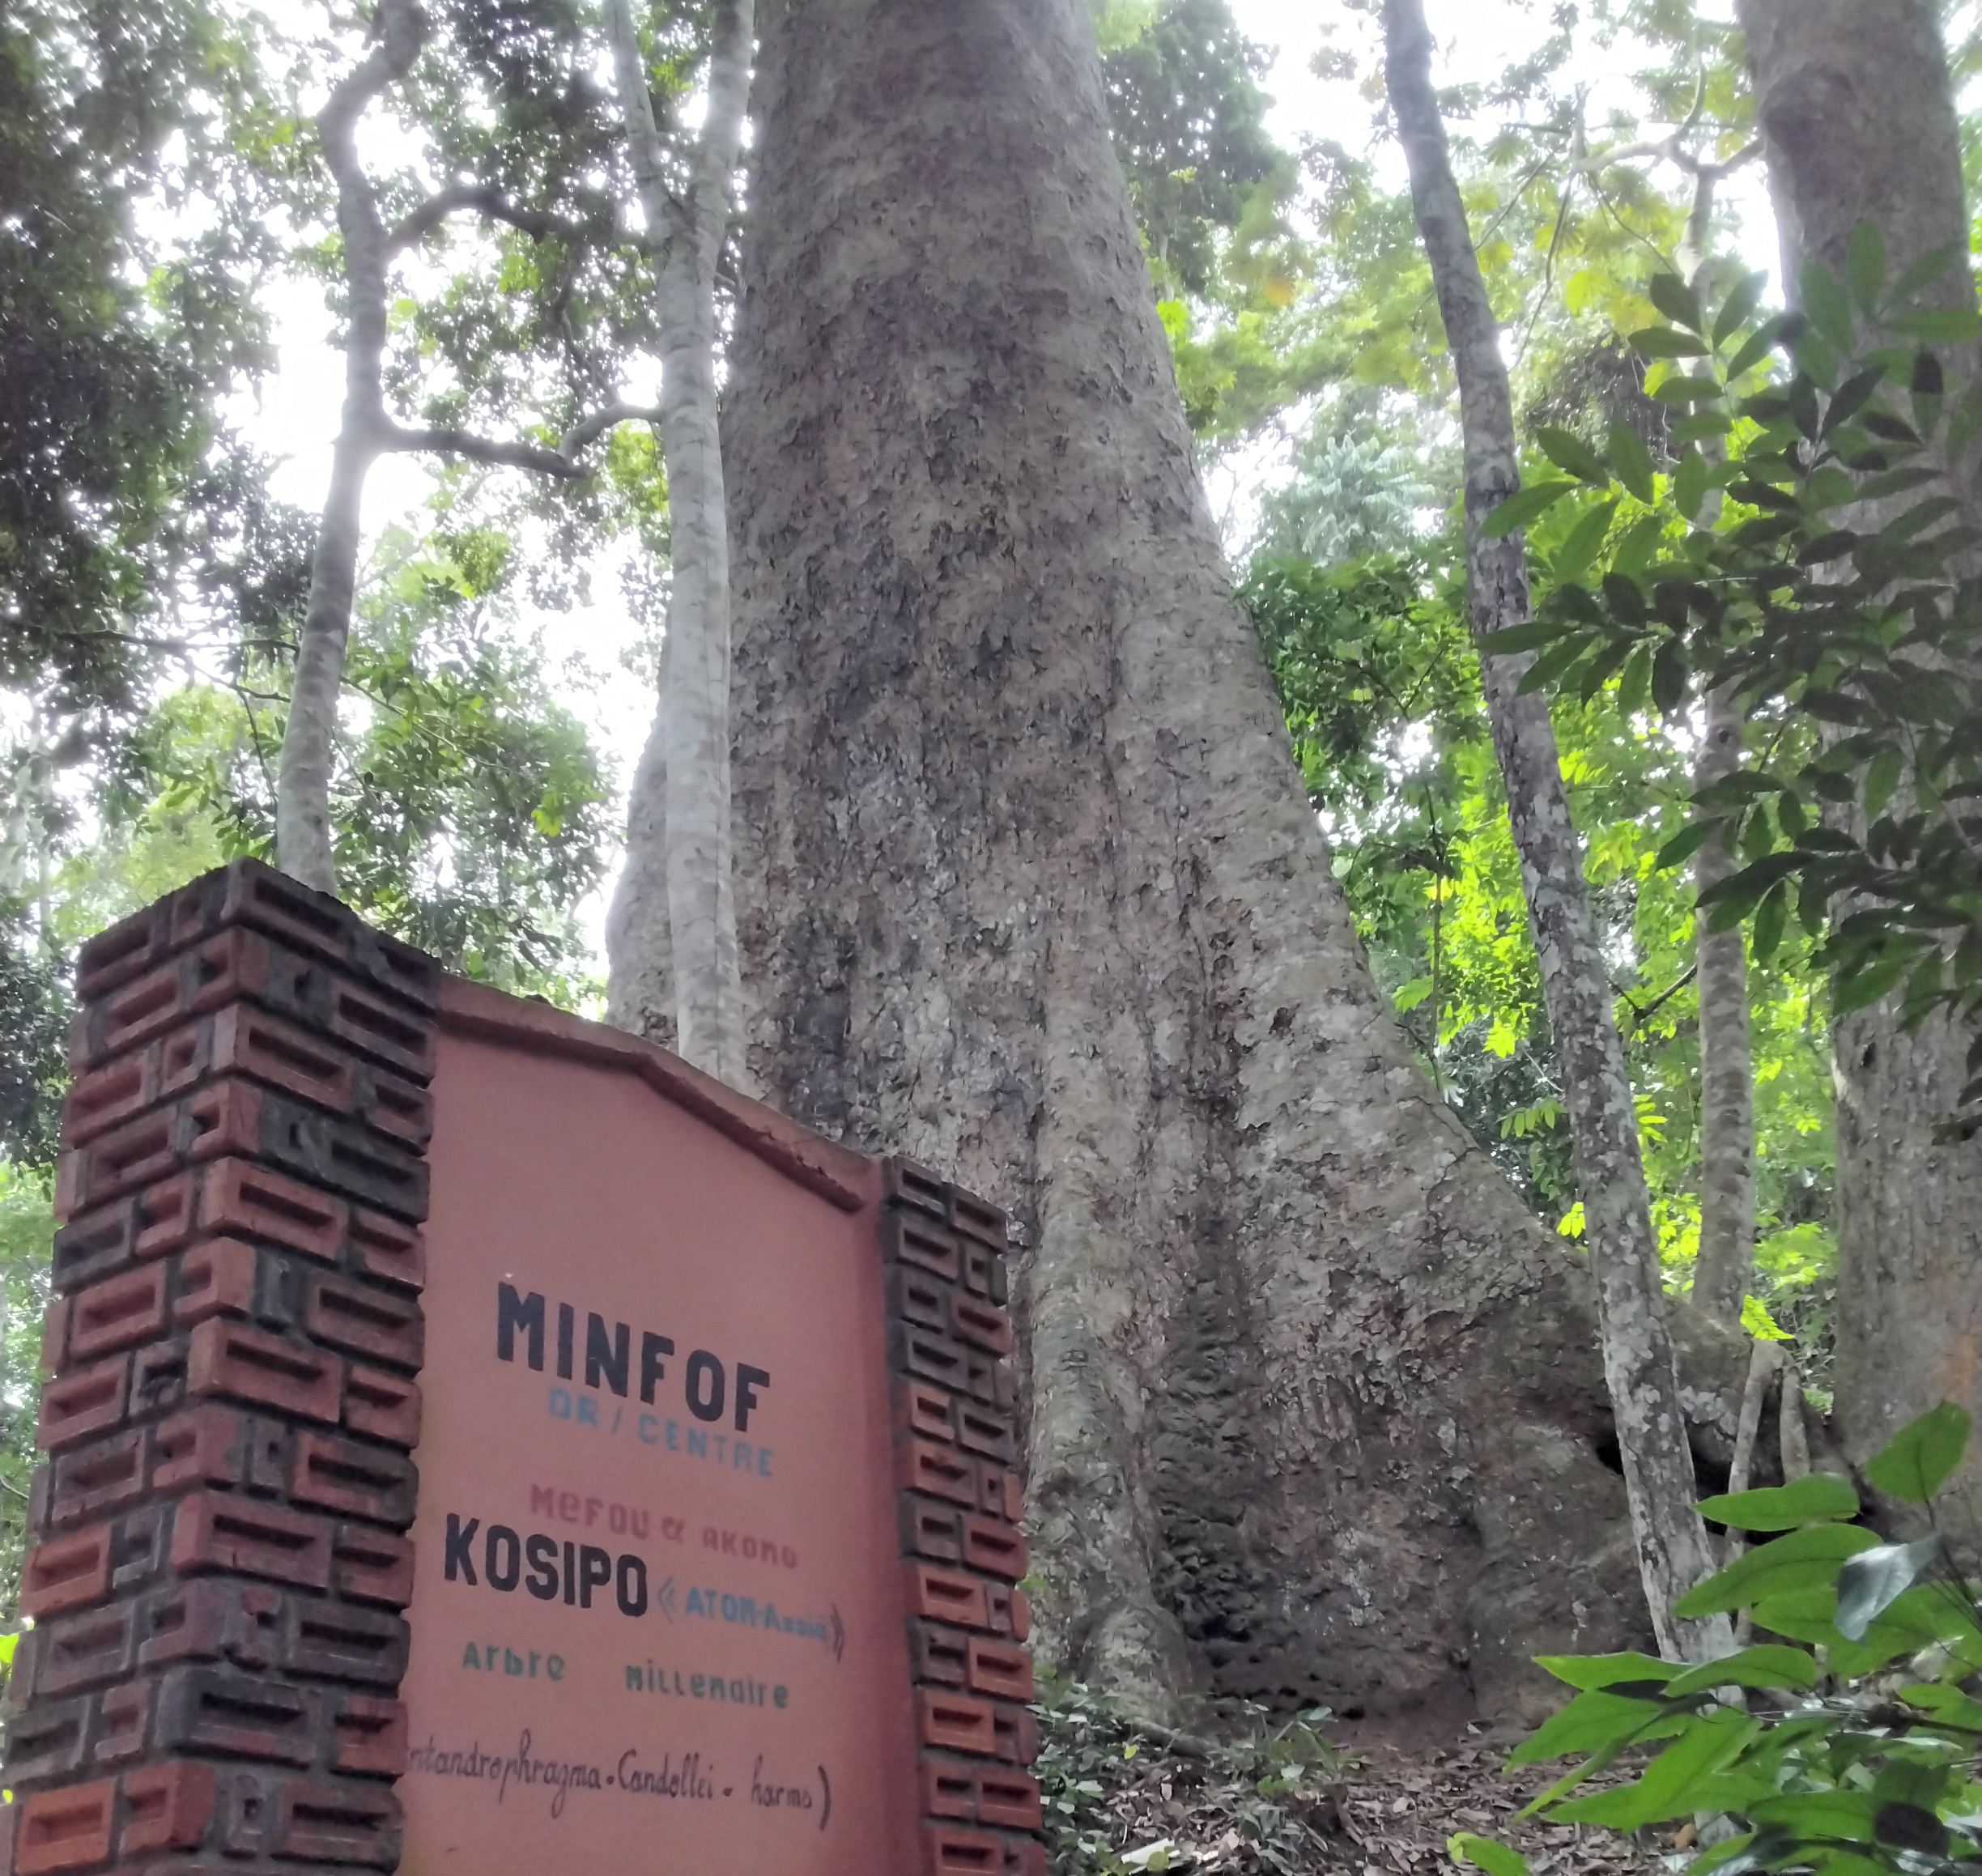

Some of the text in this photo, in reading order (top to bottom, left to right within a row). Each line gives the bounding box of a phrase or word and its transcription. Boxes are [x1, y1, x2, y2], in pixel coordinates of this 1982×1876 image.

[497, 1281, 770, 1432] MINFOF
[550, 1388, 598, 1427] DR
[639, 1412, 773, 1477] CENTRE
[444, 1512, 648, 1618] KOSIPO
